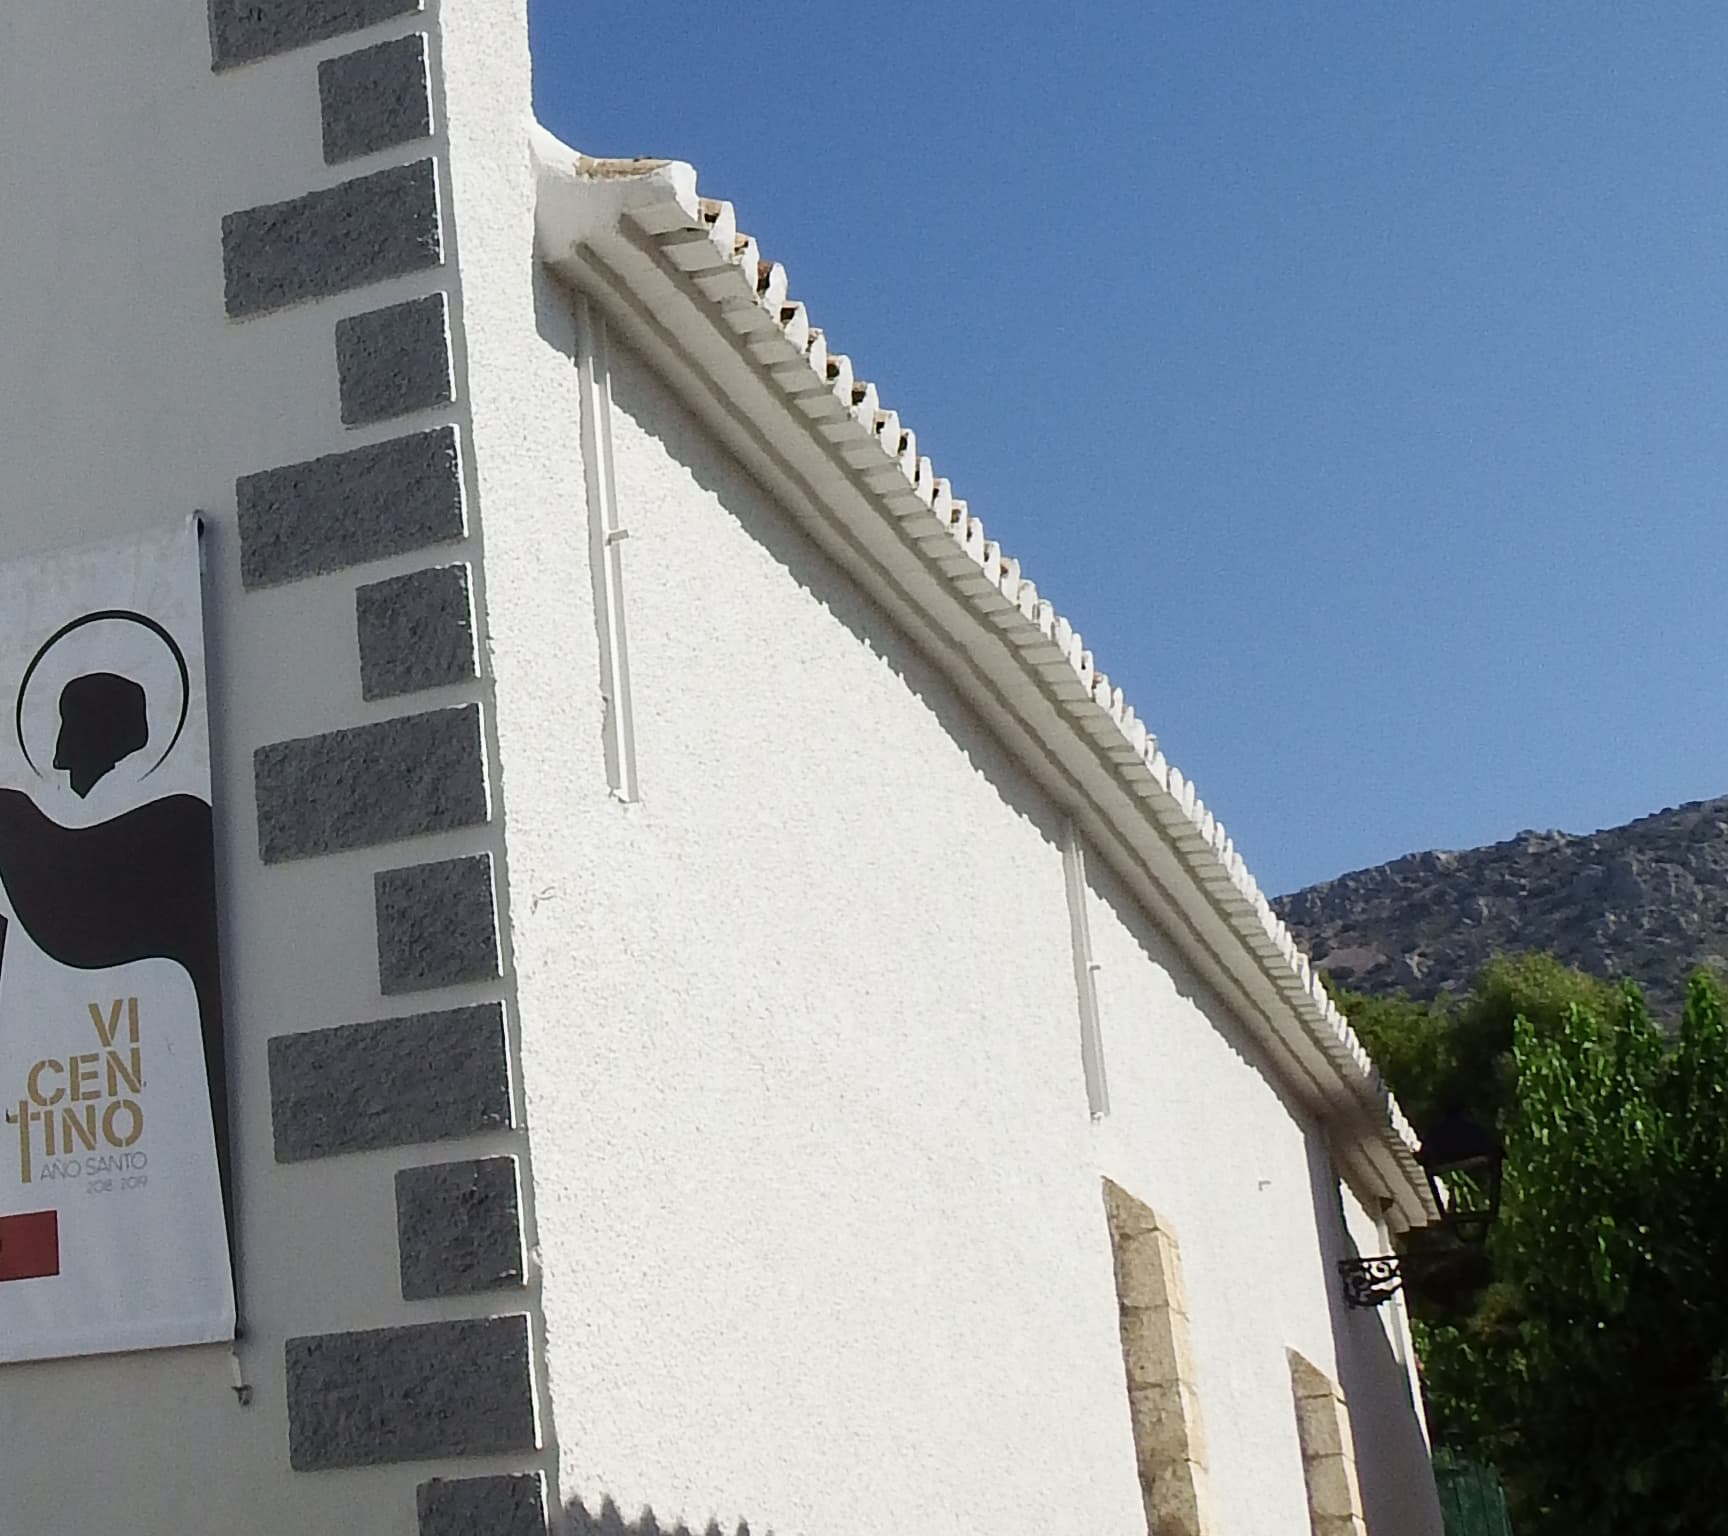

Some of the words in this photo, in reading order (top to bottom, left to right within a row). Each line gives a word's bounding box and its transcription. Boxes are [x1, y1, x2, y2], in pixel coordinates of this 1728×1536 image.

[88, 997, 140, 1046] VI
[27, 1048, 141, 1106] CEN
[40, 1158, 81, 1180] AÑO
[86, 1152, 148, 1175] SANTO
